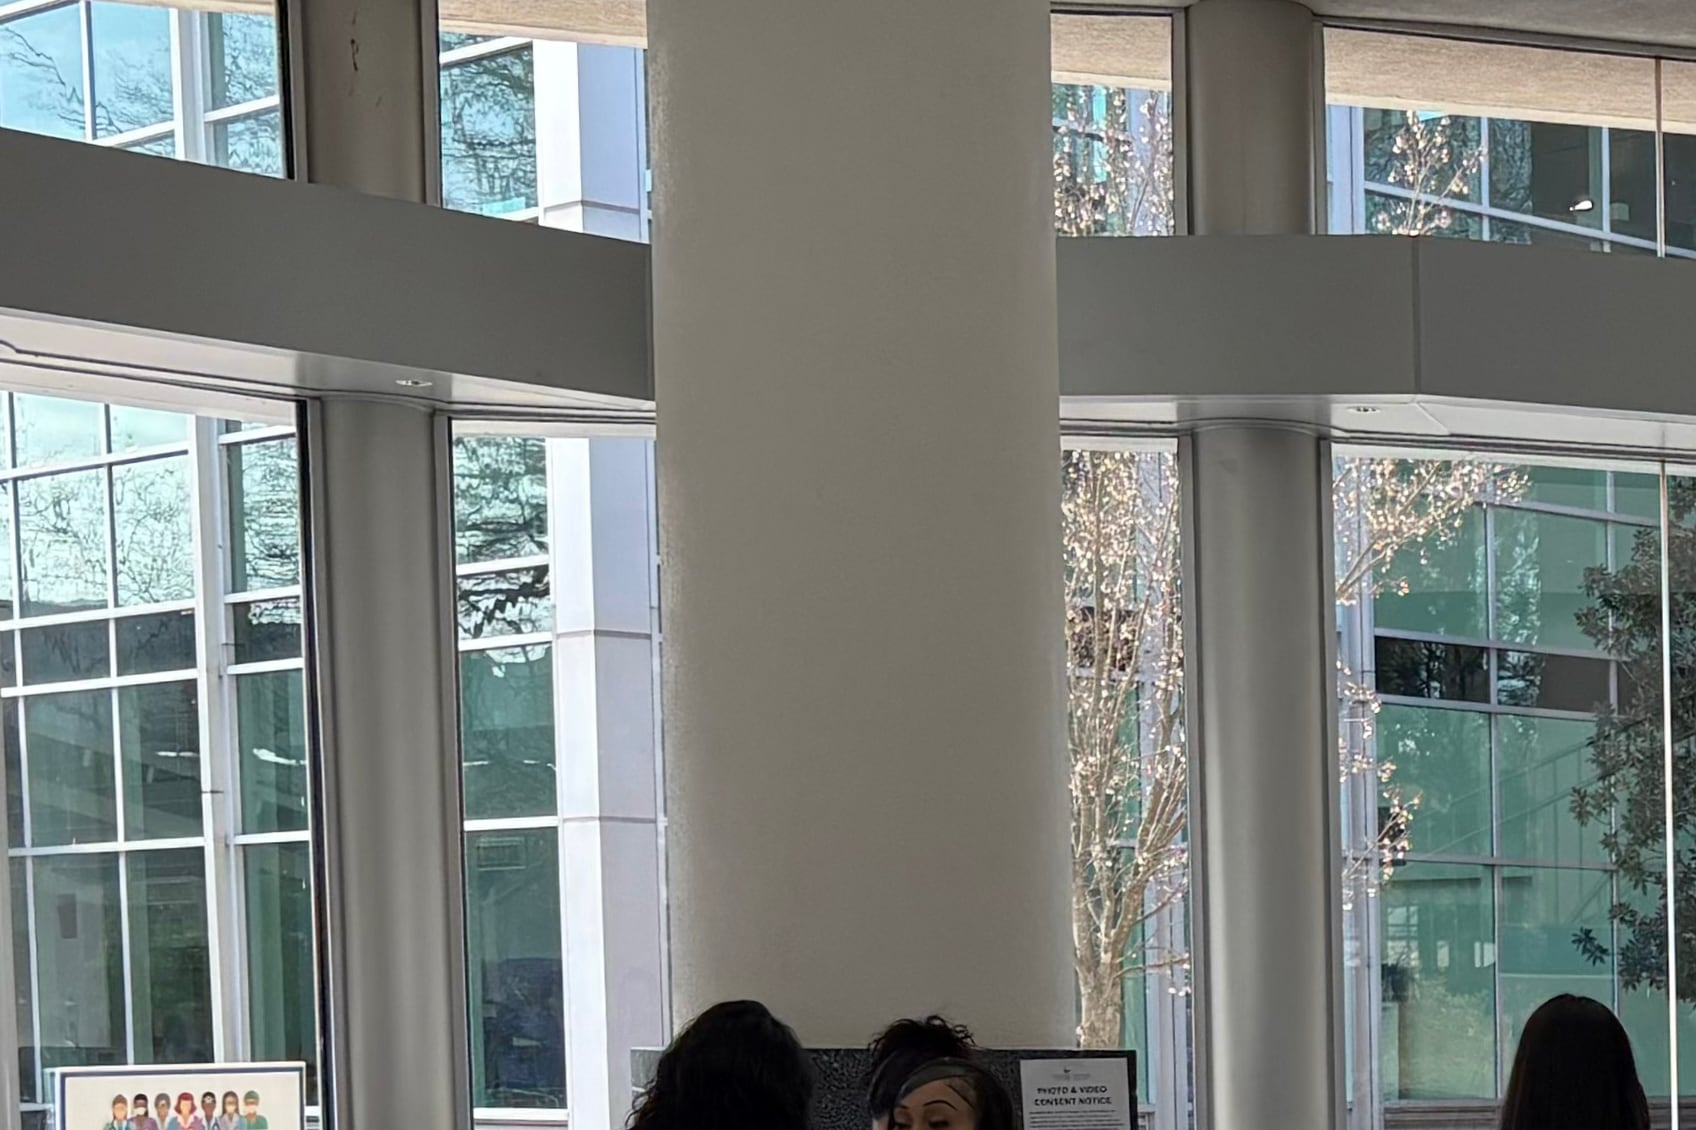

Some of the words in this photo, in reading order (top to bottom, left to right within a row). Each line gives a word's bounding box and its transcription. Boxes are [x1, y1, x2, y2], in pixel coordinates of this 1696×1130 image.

[1079, 1085, 1108, 1094] VIDEO
[1034, 1097, 1076, 1106] CONSENT
[1079, 1096, 1112, 1105] NOTICE
